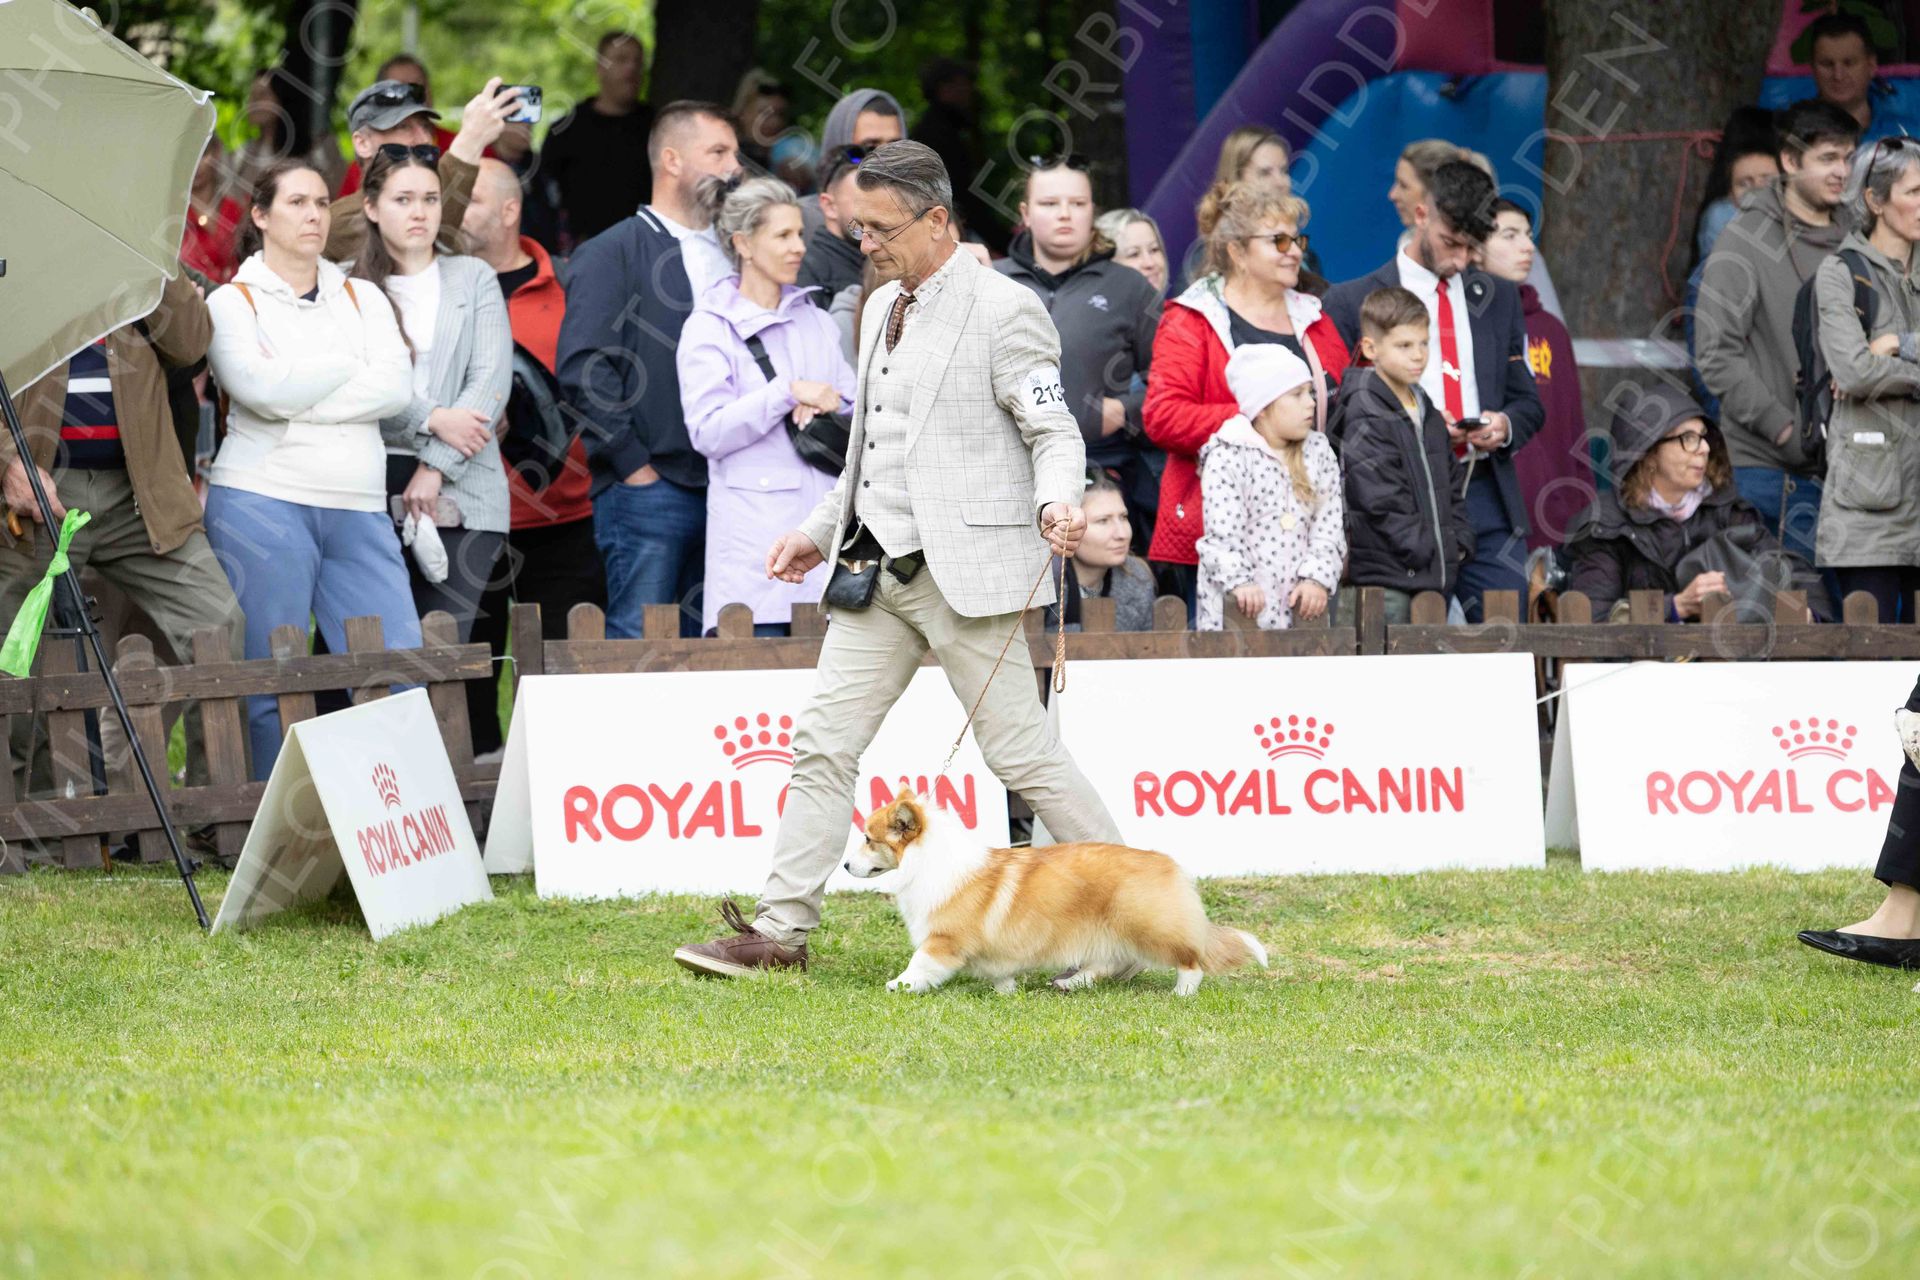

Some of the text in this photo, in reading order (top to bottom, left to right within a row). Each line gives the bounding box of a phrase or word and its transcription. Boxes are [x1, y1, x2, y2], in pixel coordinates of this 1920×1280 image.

[562, 780, 763, 843] ROYAL
[1133, 766, 1464, 817] ROYAL CANIN
[1646, 769, 1815, 816] ROYAL
[357, 804, 456, 878] ROYAL CANIN
